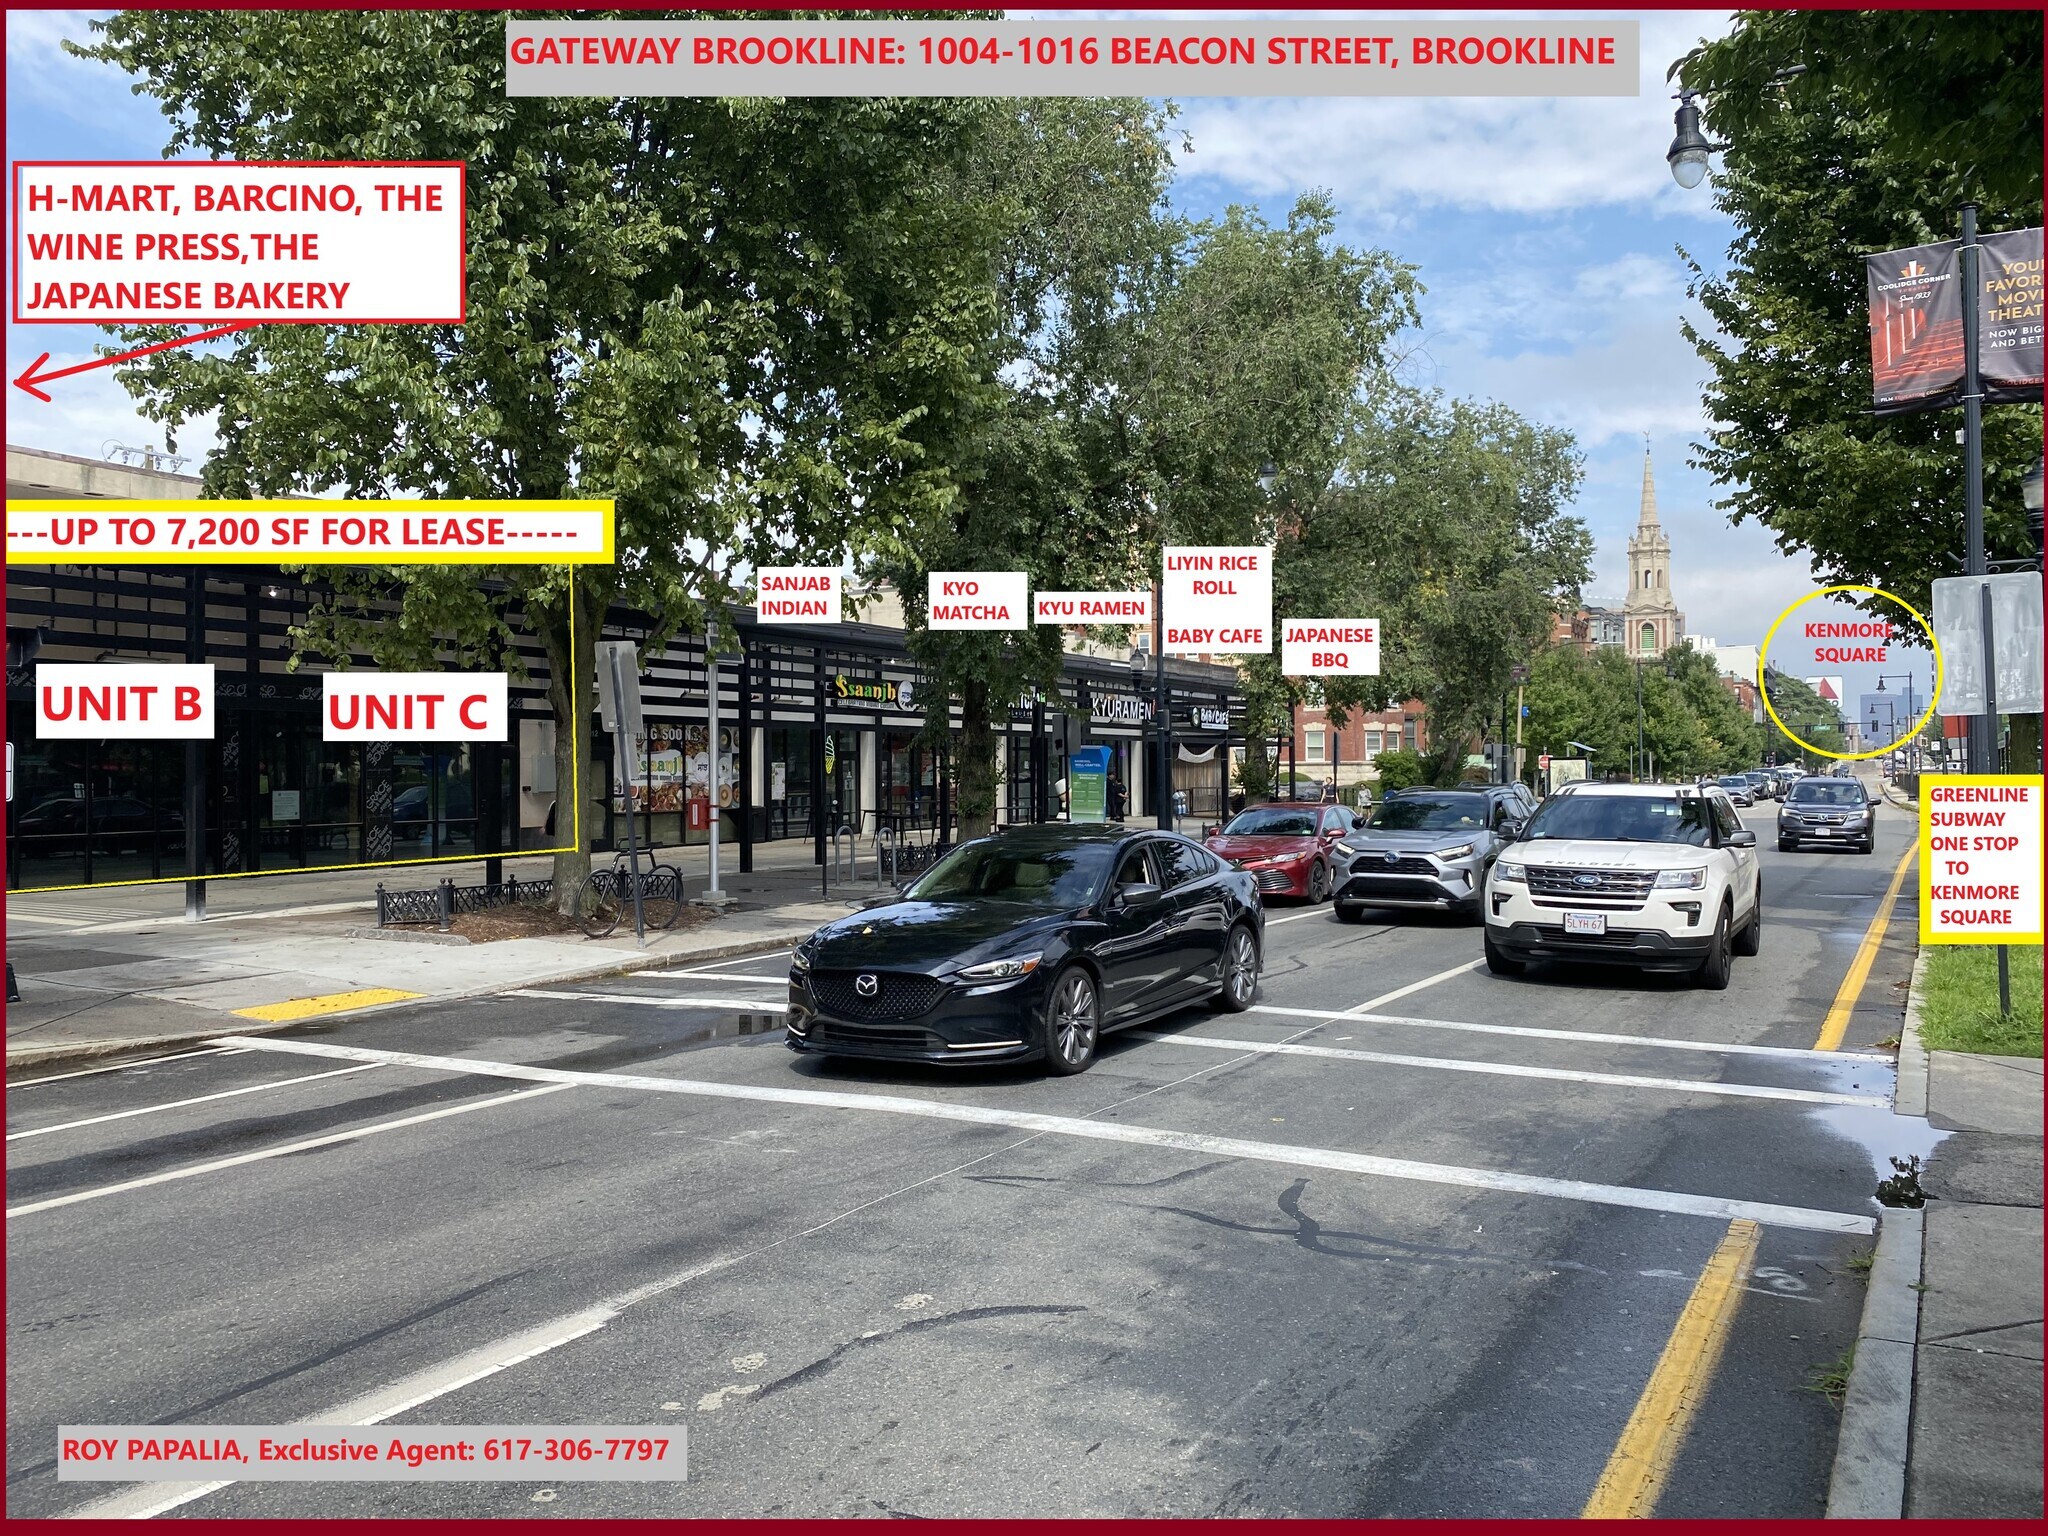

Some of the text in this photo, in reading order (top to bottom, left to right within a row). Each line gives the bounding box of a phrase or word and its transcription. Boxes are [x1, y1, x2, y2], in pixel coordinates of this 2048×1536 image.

[2002, 260, 2044, 274] YOU
[1877, 274, 1951, 291] COOLIDGE CORNER
[1986, 274, 2044, 292] FAVOR
[1914, 291, 1931, 299] 1933
[1989, 325, 2044, 338] NOW BIG
[1990, 338, 2016, 348] AND
[1092, 698, 1151, 720] KYURAMEN
[1578, 876, 1595, 884] Ford
[1591, 920, 1603, 930] 67
